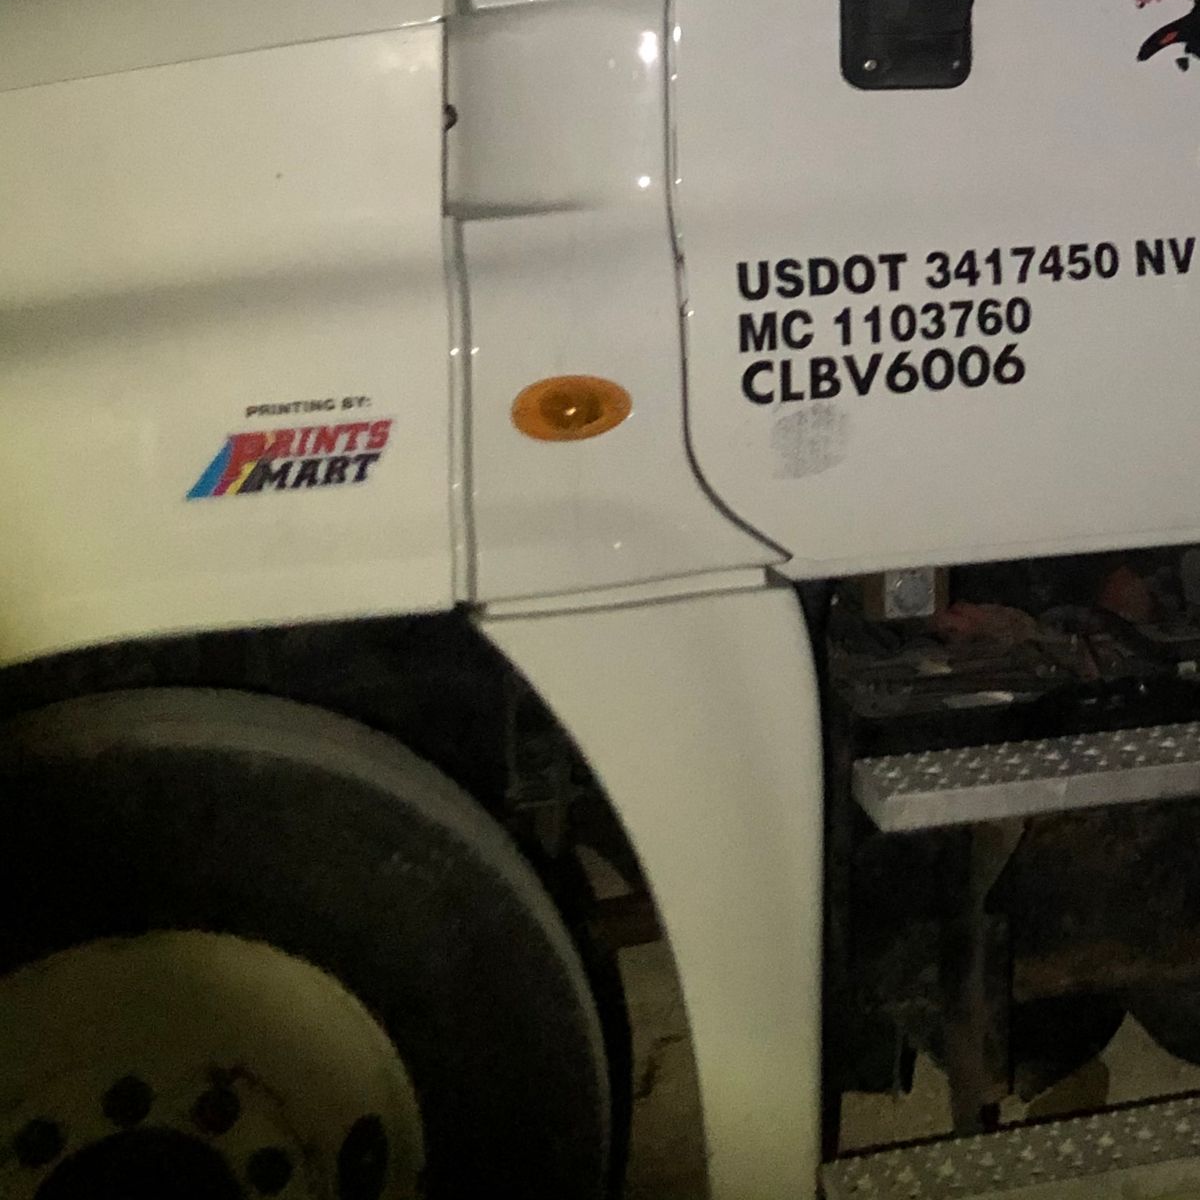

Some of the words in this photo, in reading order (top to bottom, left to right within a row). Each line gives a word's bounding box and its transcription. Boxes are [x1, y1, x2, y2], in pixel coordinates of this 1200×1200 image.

[736, 252, 908, 301] USDOT
[925, 241, 1121, 290] 3417450
[1134, 236, 1196, 278] NV
[738, 309, 815, 353] MC
[833, 296, 1033, 347] 1103760
[740, 343, 1028, 406] CLBV6006
[246, 399, 336, 417] PRINTING
[236, 452, 382, 494] MART
